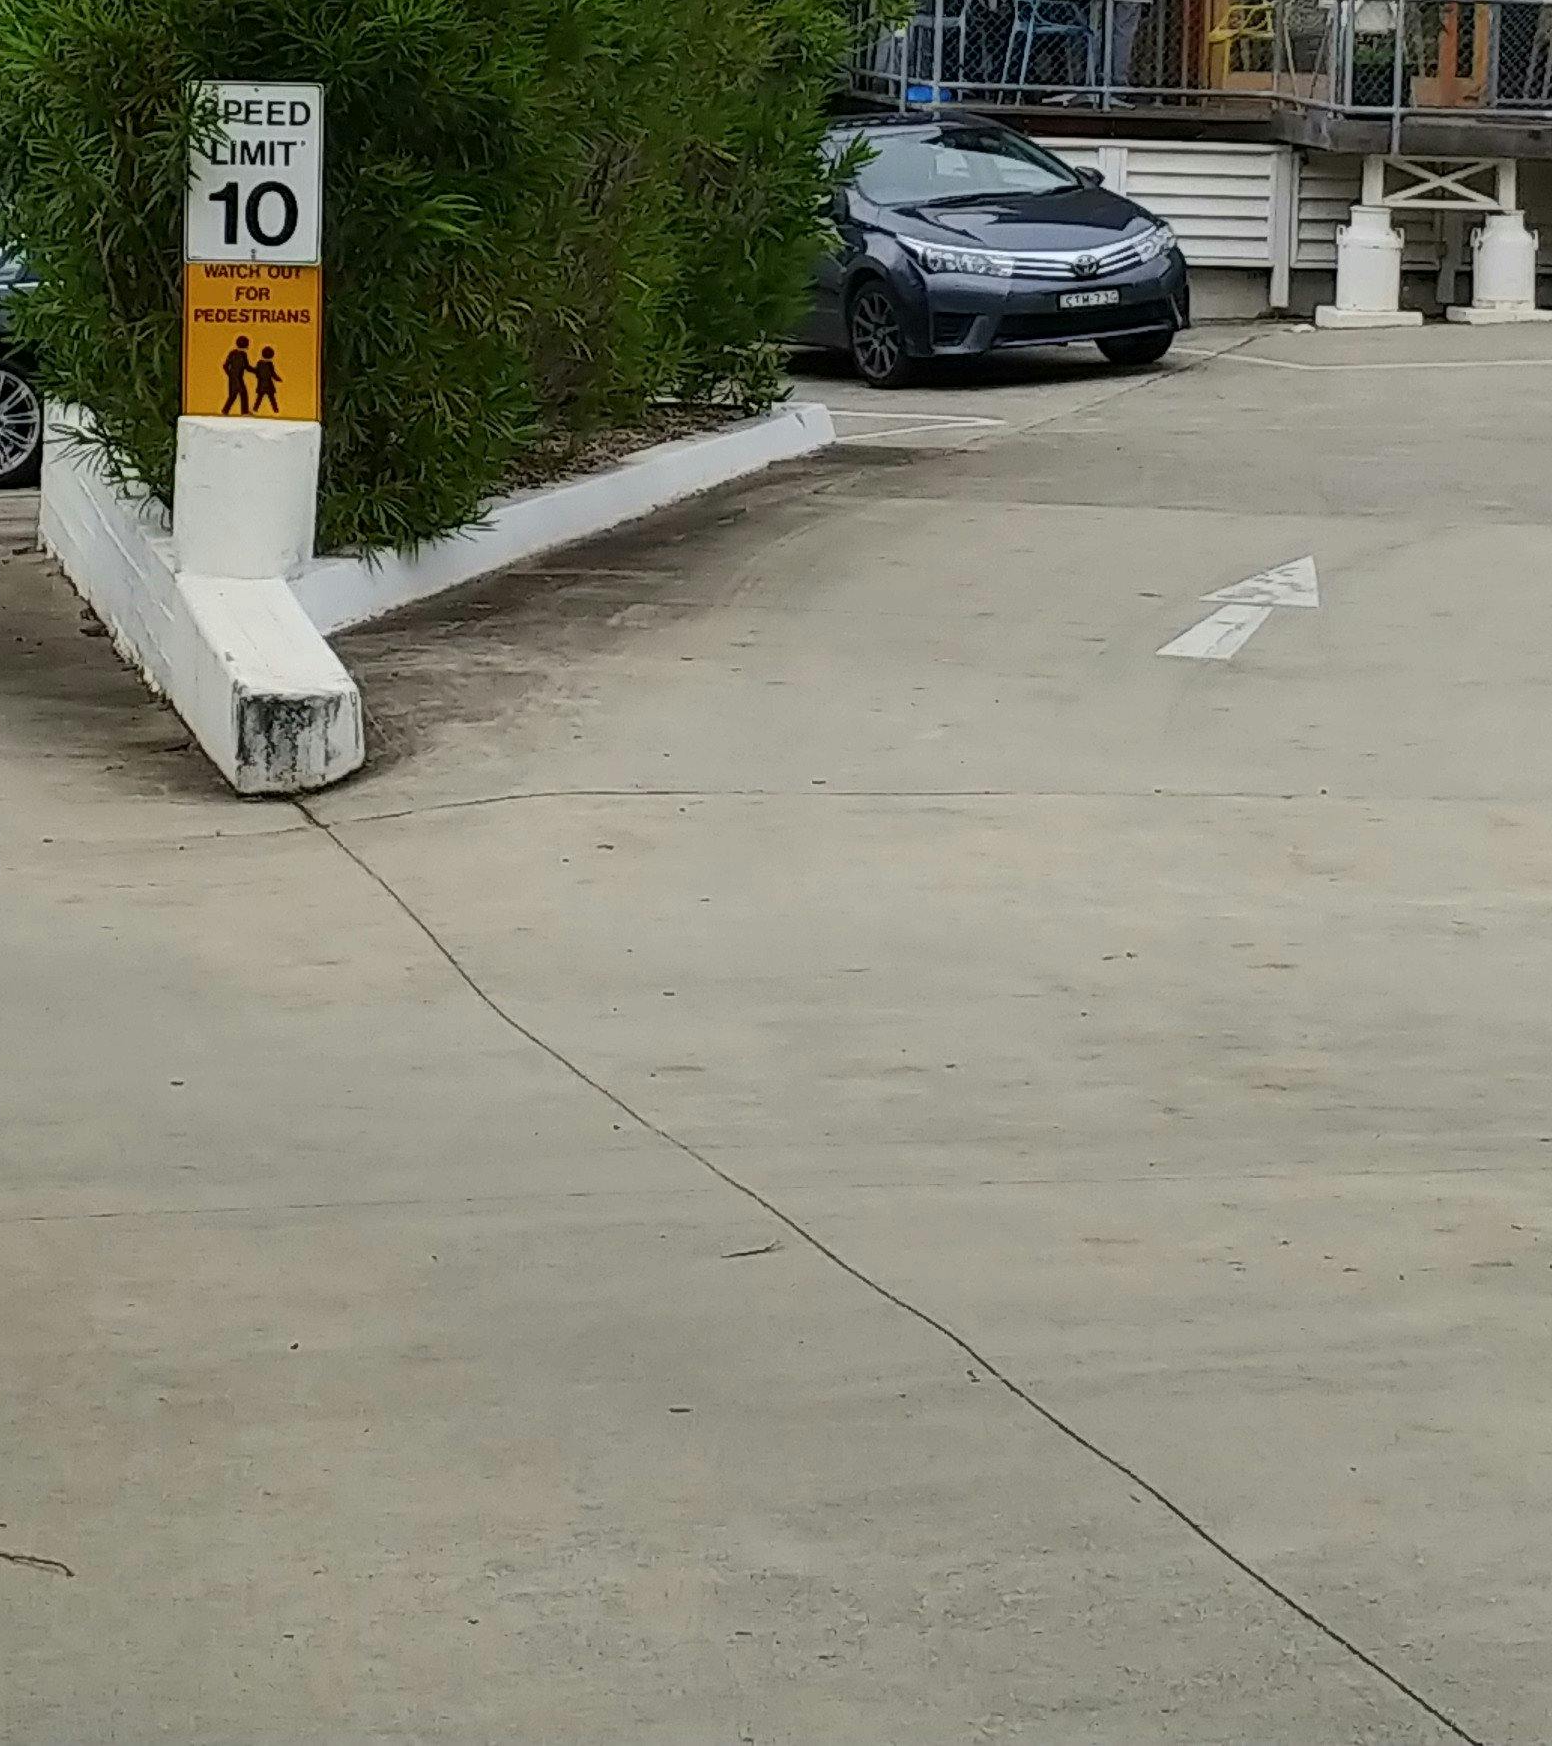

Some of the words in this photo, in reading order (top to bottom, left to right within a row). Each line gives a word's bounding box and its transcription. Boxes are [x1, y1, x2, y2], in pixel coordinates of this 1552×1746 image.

[196, 99, 311, 126] PEED
[210, 140, 297, 166] LIMIT
[208, 180, 299, 247] 10
[204, 263, 261, 280] WATCH
[267, 264, 302, 280] OUT
[234, 285, 271, 302] FOR
[193, 308, 311, 324] PEDESTRIANS
